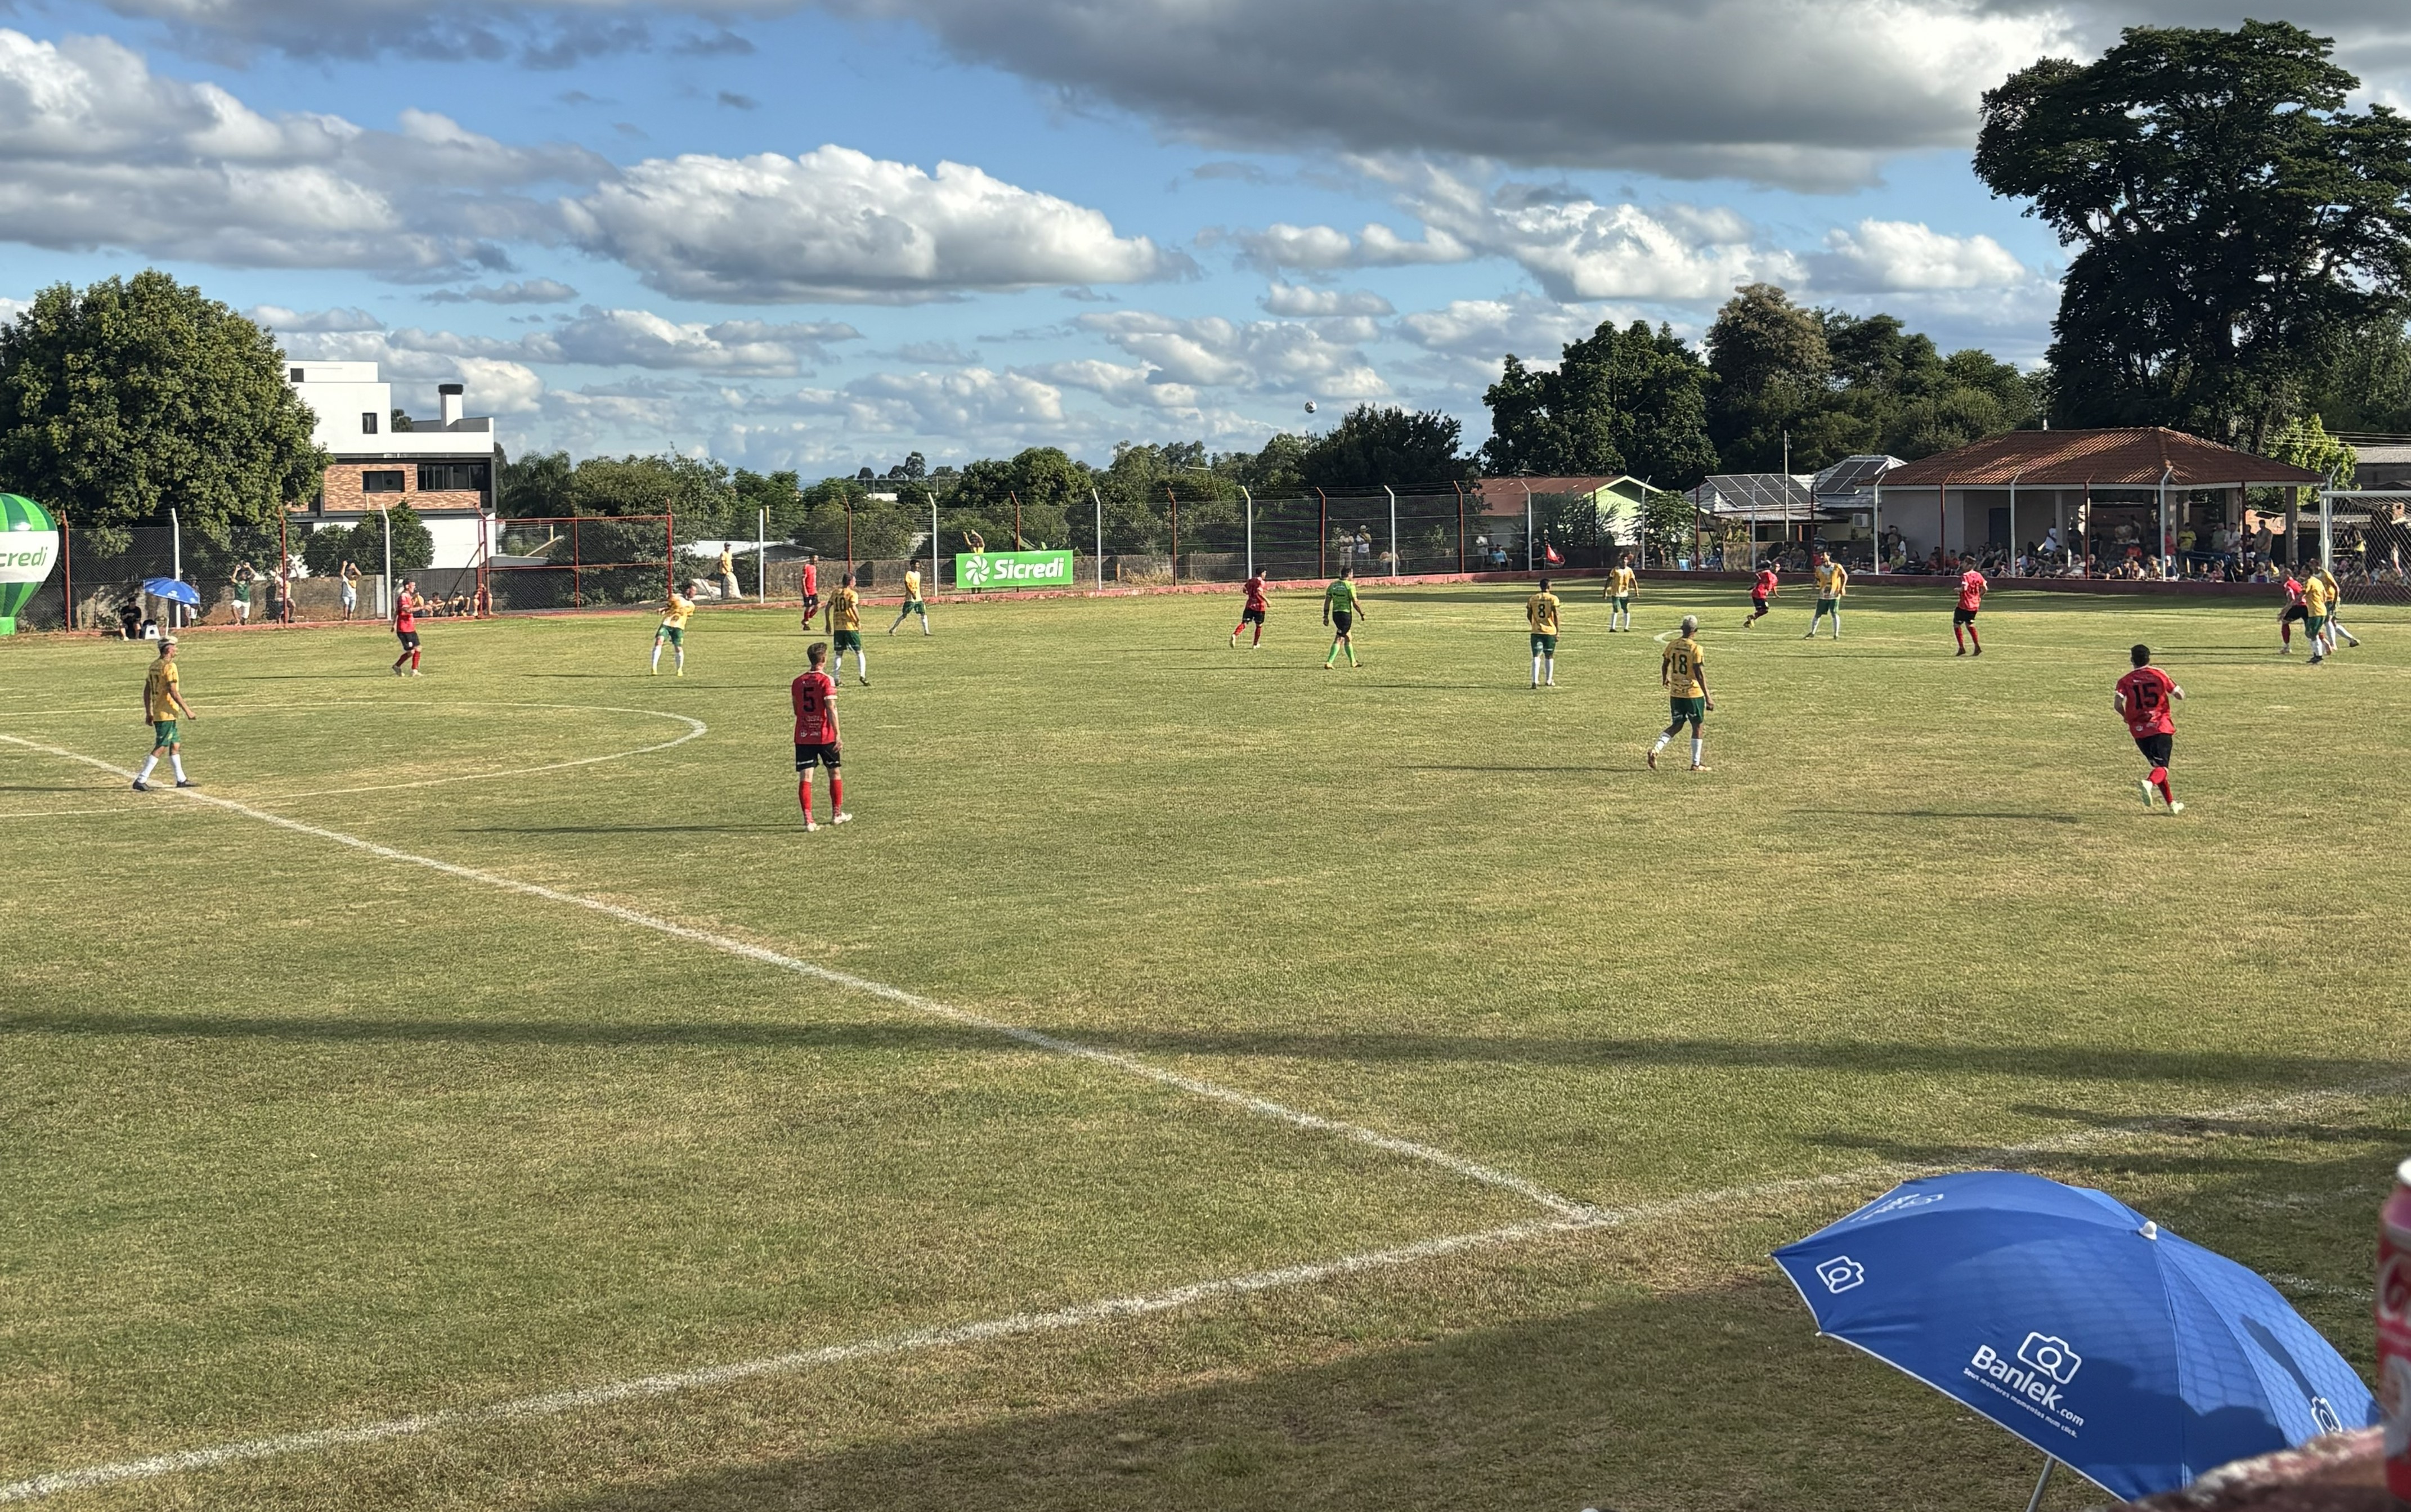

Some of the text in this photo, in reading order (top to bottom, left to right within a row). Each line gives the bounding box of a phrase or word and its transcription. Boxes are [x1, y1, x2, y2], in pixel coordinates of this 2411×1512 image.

[993, 557, 1065, 580] Sicredi
[835, 597, 846, 612] 10
[1538, 604, 1545, 618] 8
[1671, 653, 1687, 675] 18
[803, 687, 815, 712] 5
[2133, 683, 2159, 710] 15
